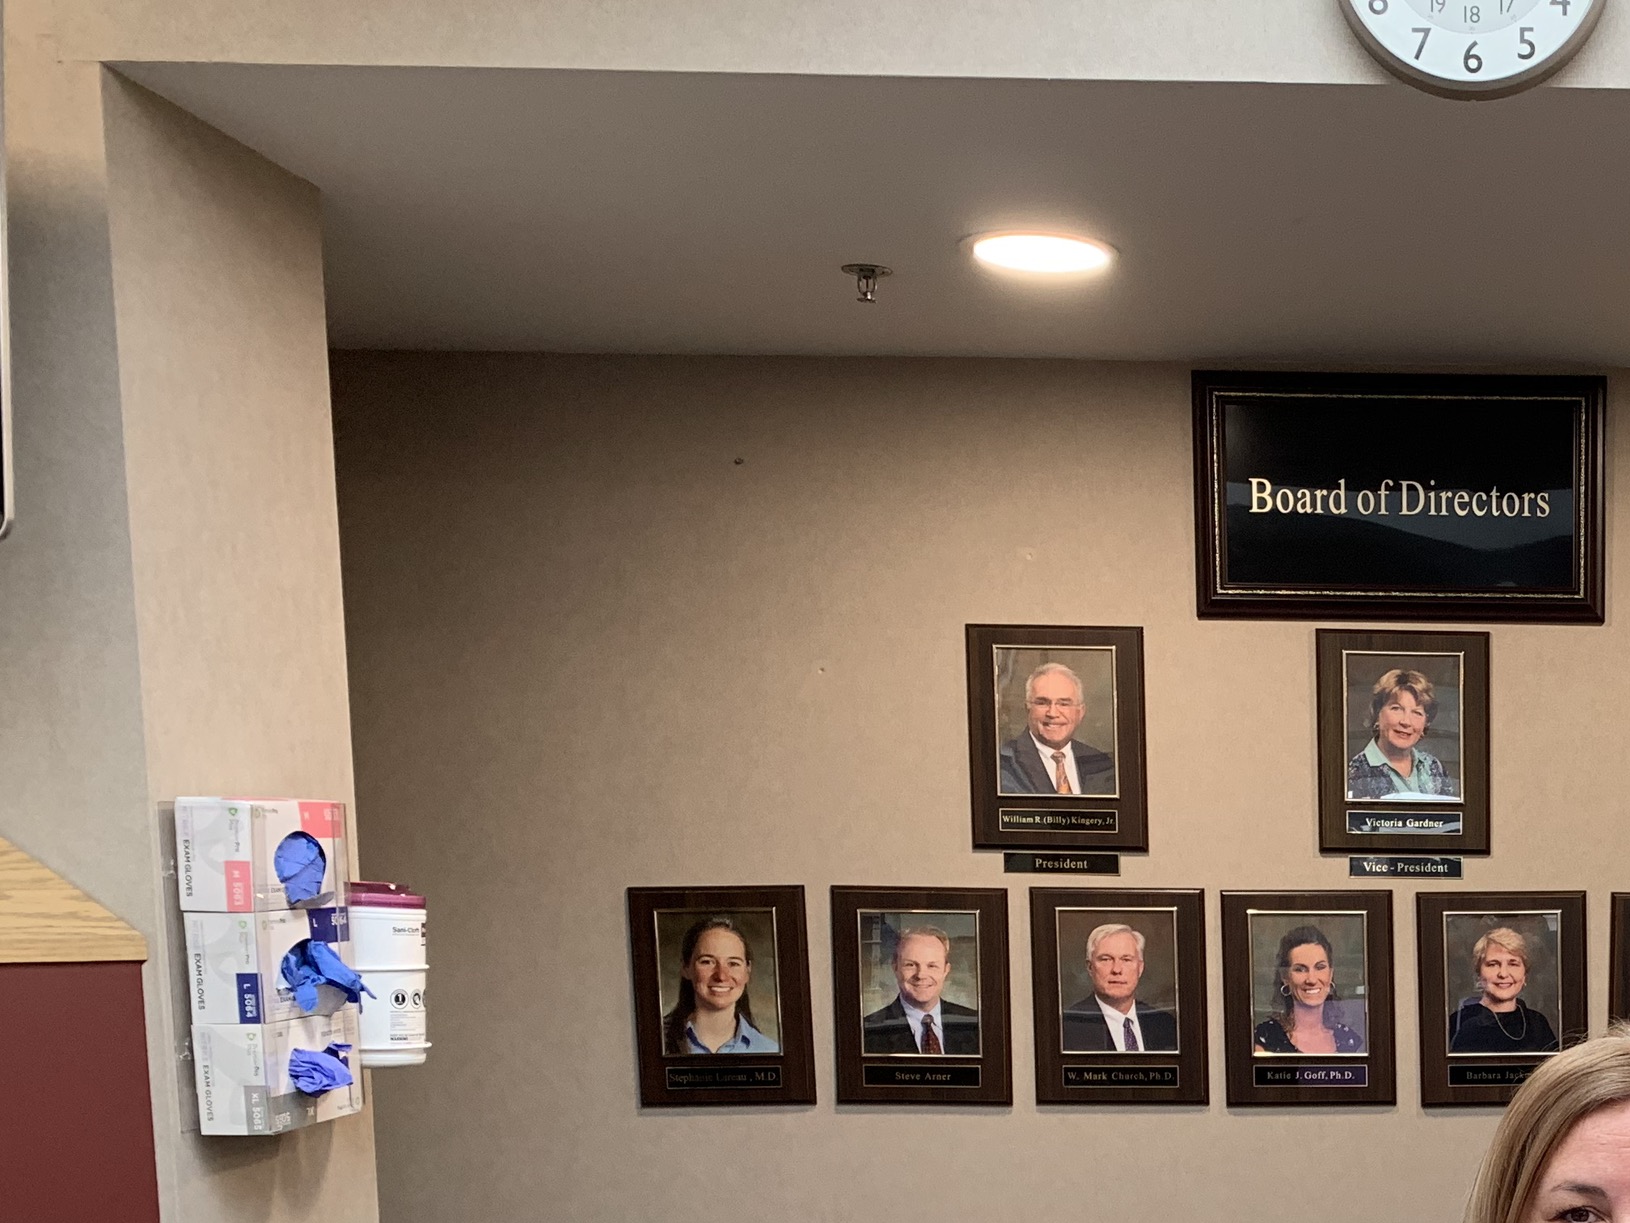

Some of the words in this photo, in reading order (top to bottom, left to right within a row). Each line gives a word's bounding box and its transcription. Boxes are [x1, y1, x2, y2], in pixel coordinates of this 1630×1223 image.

[1463, 5, 1480, 23] 18
[1411, 27, 1432, 61] 7
[1517, 27, 1536, 60] 5
[1463, 40, 1483, 74] 6
[1248, 477, 1348, 514] Board
[1356, 478, 1393, 516] of
[1399, 479, 1551, 518] Directors
[1002, 815, 1034, 824] William
[1043, 816, 1070, 826] (Billy)
[1071, 816, 1105, 827] Kingery,
[1106, 817, 1116, 825] Jr.
[1365, 818, 1403, 827] Victoria
[1406, 818, 1444, 828] Gardner
[183, 839, 191, 863] EXAM
[1035, 858, 1088, 869] President
[1363, 861, 1388, 872] Vice
[1397, 862, 1449, 873] President
[184, 863, 193, 897] GLOVES
[194, 953, 202, 977] EXAM
[196, 977, 206, 1011] GLOVES
[244, 993, 254, 1018] 5064
[202, 1064, 211, 1088] EXAM
[754, 1071, 779, 1081] M.D.
[895, 1071, 921, 1080] Steve
[925, 1072, 952, 1081] Arner
[1067, 1071, 1080, 1081] W.
[1083, 1071, 1107, 1081] Mark
[1111, 1071, 1147, 1082] Church,
[1149, 1071, 1175, 1081] Ph.D.
[1267, 1071, 1291, 1080] Katie
[1295, 1071, 1303, 1080] J.
[1304, 1071, 1329, 1081] Goff,
[1330, 1071, 1355, 1080] Ph.D.
[1466, 1071, 1501, 1080] Barbara
[1505, 1071, 1532, 1080] Jack
[205, 1089, 214, 1122] GLOVES
[251, 1092, 260, 1104] XL
[252, 1106, 263, 1130] 5065
